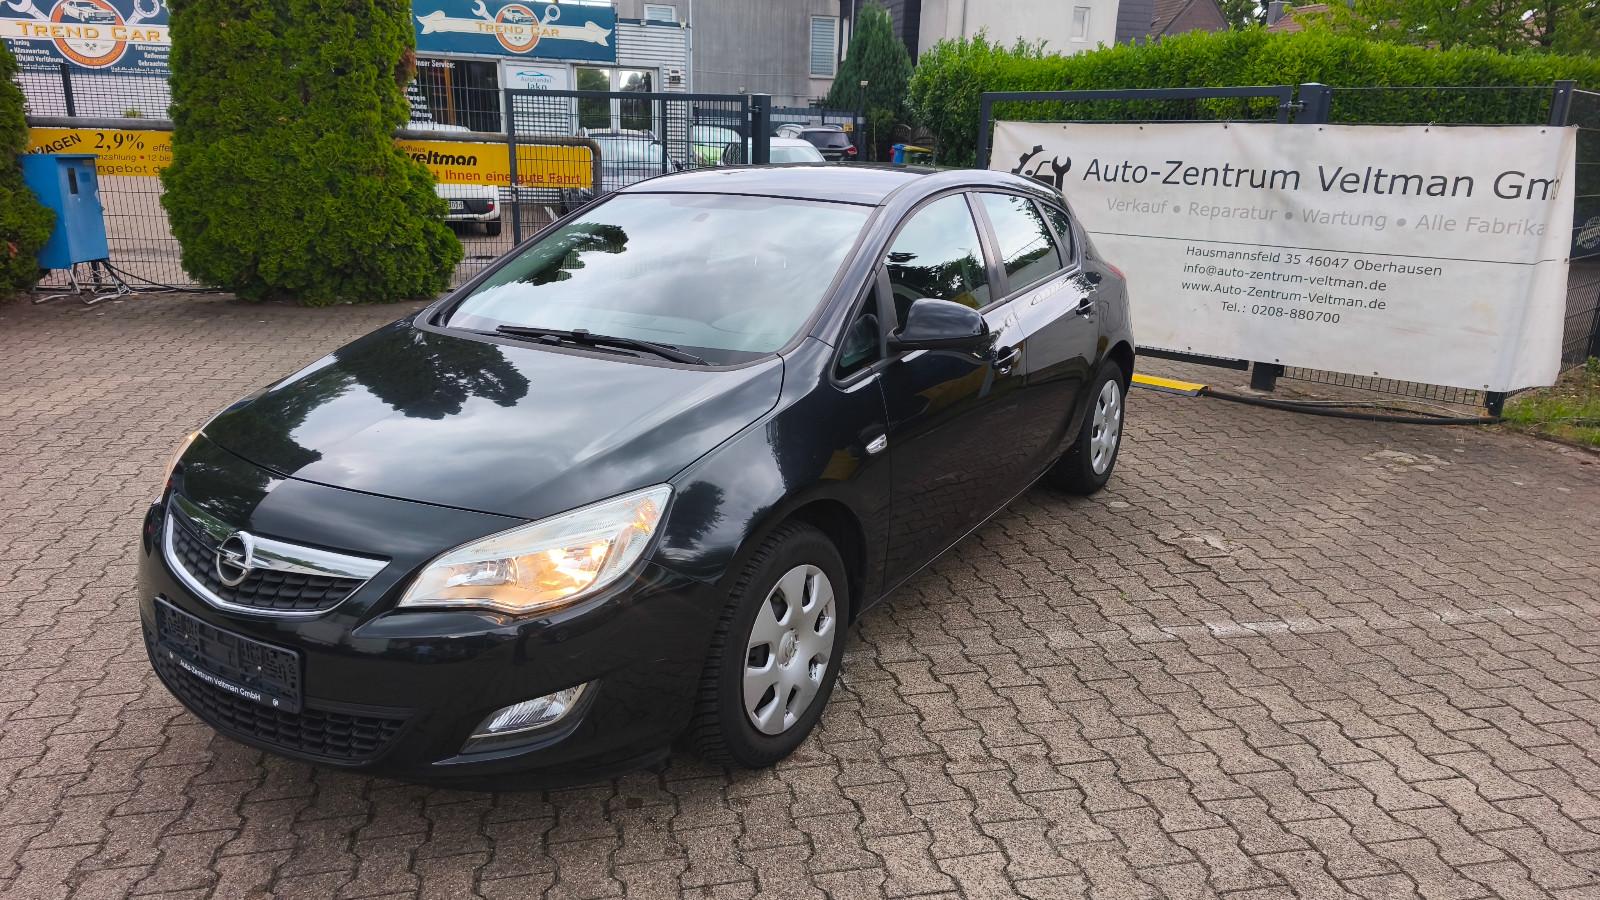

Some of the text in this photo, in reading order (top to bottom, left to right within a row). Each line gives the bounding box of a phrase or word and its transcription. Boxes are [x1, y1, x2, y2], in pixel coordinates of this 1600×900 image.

[15, 21, 160, 42] TREND CAR
[475, 22, 560, 37] TREND CAR
[28, 132, 83, 154] WAGEN
[94, 132, 145, 152] 2,9%
[446, 169, 481, 181] Ihnen
[1083, 158, 1300, 190] Auto-Zentrum
[1318, 165, 1475, 197] Veltman
[1106, 198, 1168, 214] Verkauf
[1188, 201, 1277, 221] Reparatur
[1302, 208, 1388, 231] Wartung
[1415, 214, 1457, 232] Alle
[1186, 245, 1442, 276] Hausmannsfeld 35 46047 Oberhausen
[1183, 262, 1387, 291] info@auto-zentrum-veltman.de
[1181, 281, 1387, 310] www.Auto-Zentrum-Veltman.de
[1221, 301, 1341, 324] Tel.: 0208-880700
